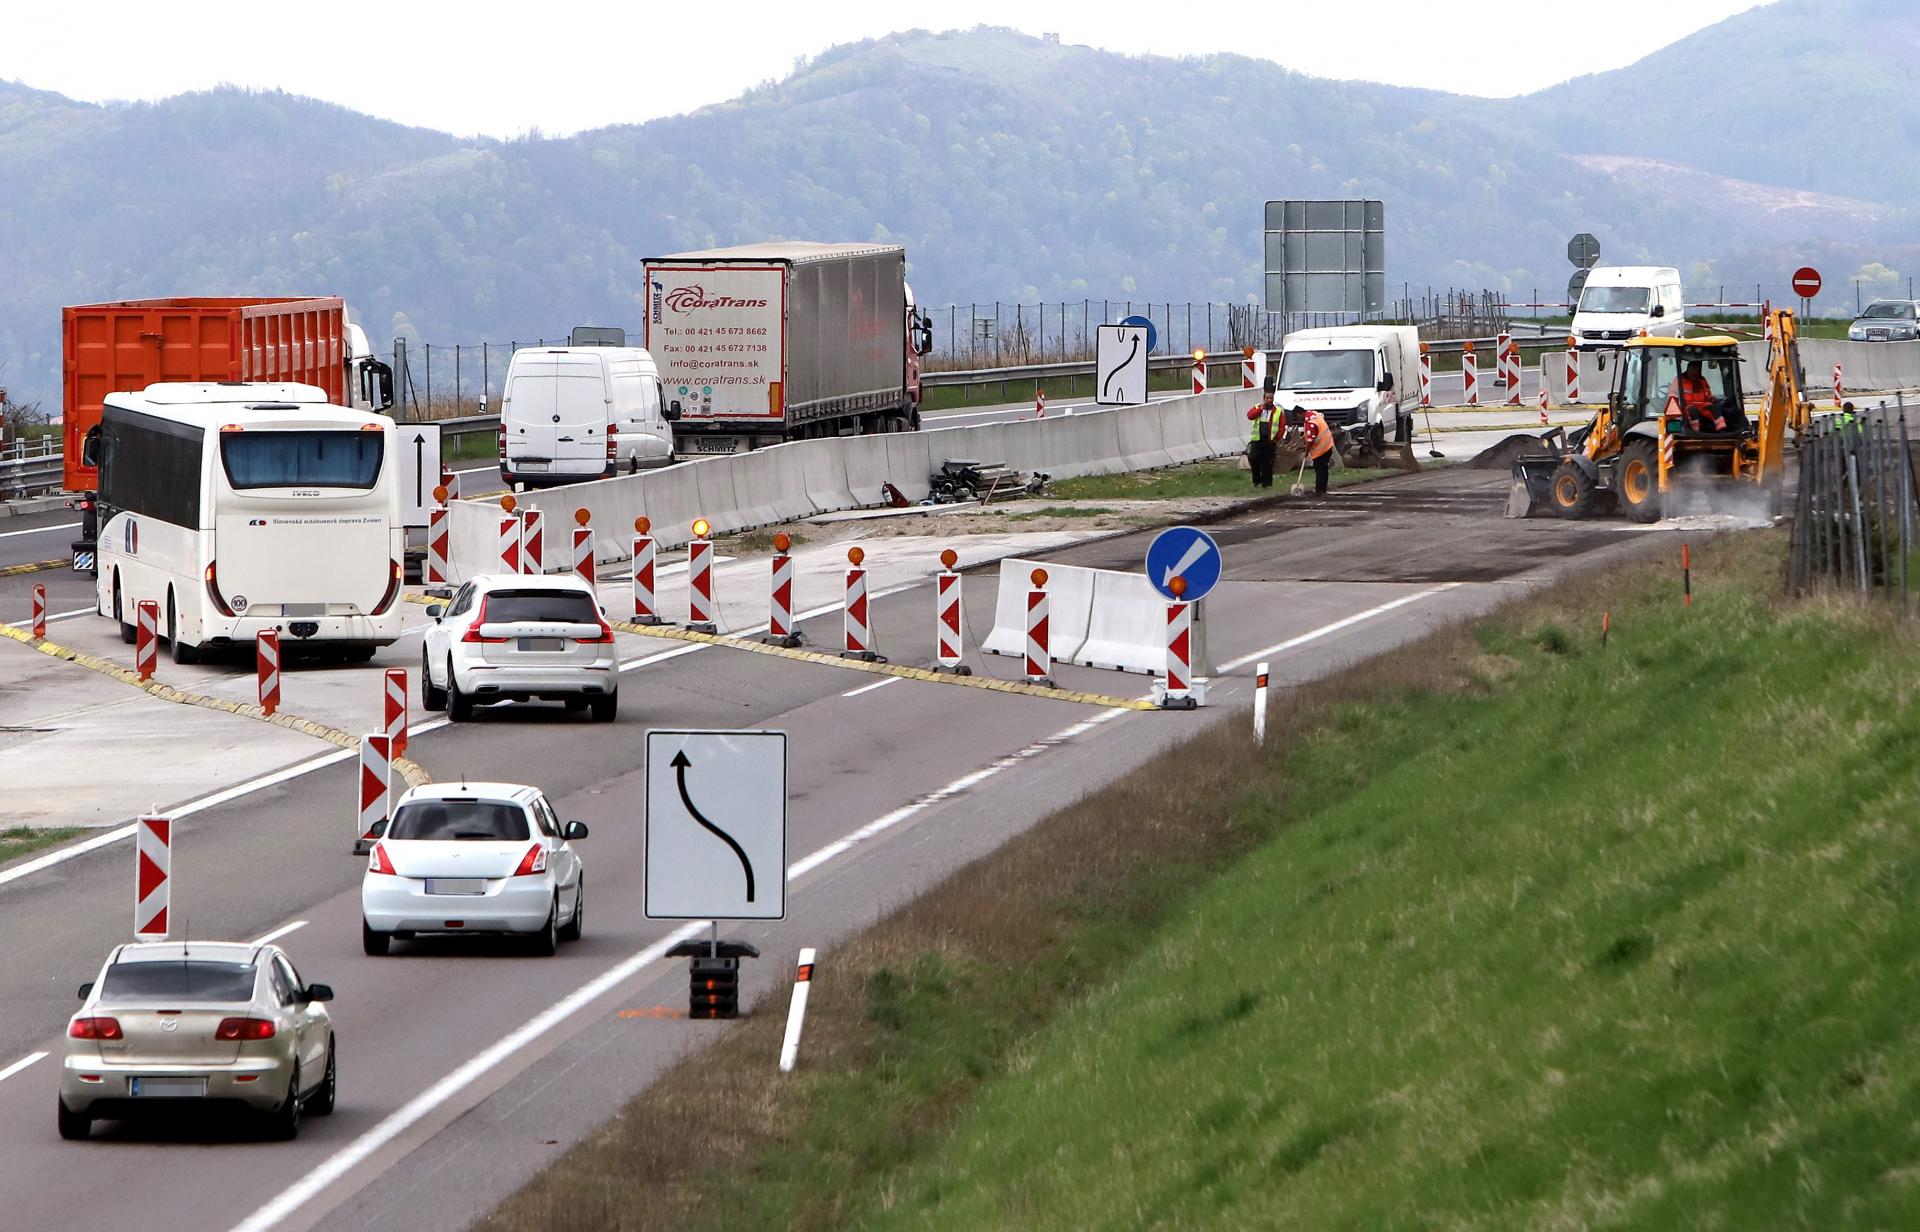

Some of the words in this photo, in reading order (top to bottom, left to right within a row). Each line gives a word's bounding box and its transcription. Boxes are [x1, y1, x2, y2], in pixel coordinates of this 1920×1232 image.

[681, 297, 767, 307] CoraTrans
[664, 327, 683, 336] Tel.:
[685, 328, 696, 336] 00
[698, 328, 713, 336] 421
[715, 327, 726, 335] 45
[728, 327, 744, 335] 673
[746, 327, 767, 336] 8662
[663, 344, 683, 353] Fax:
[685, 345, 696, 353] 00
[698, 345, 713, 353] 421
[715, 344, 726, 352] 45
[728, 344, 744, 352] 672
[746, 344, 767, 352] 7138
[670, 360, 759, 369] info@coratrans.sk
[663, 375, 766, 385] www.coratrans.sk
